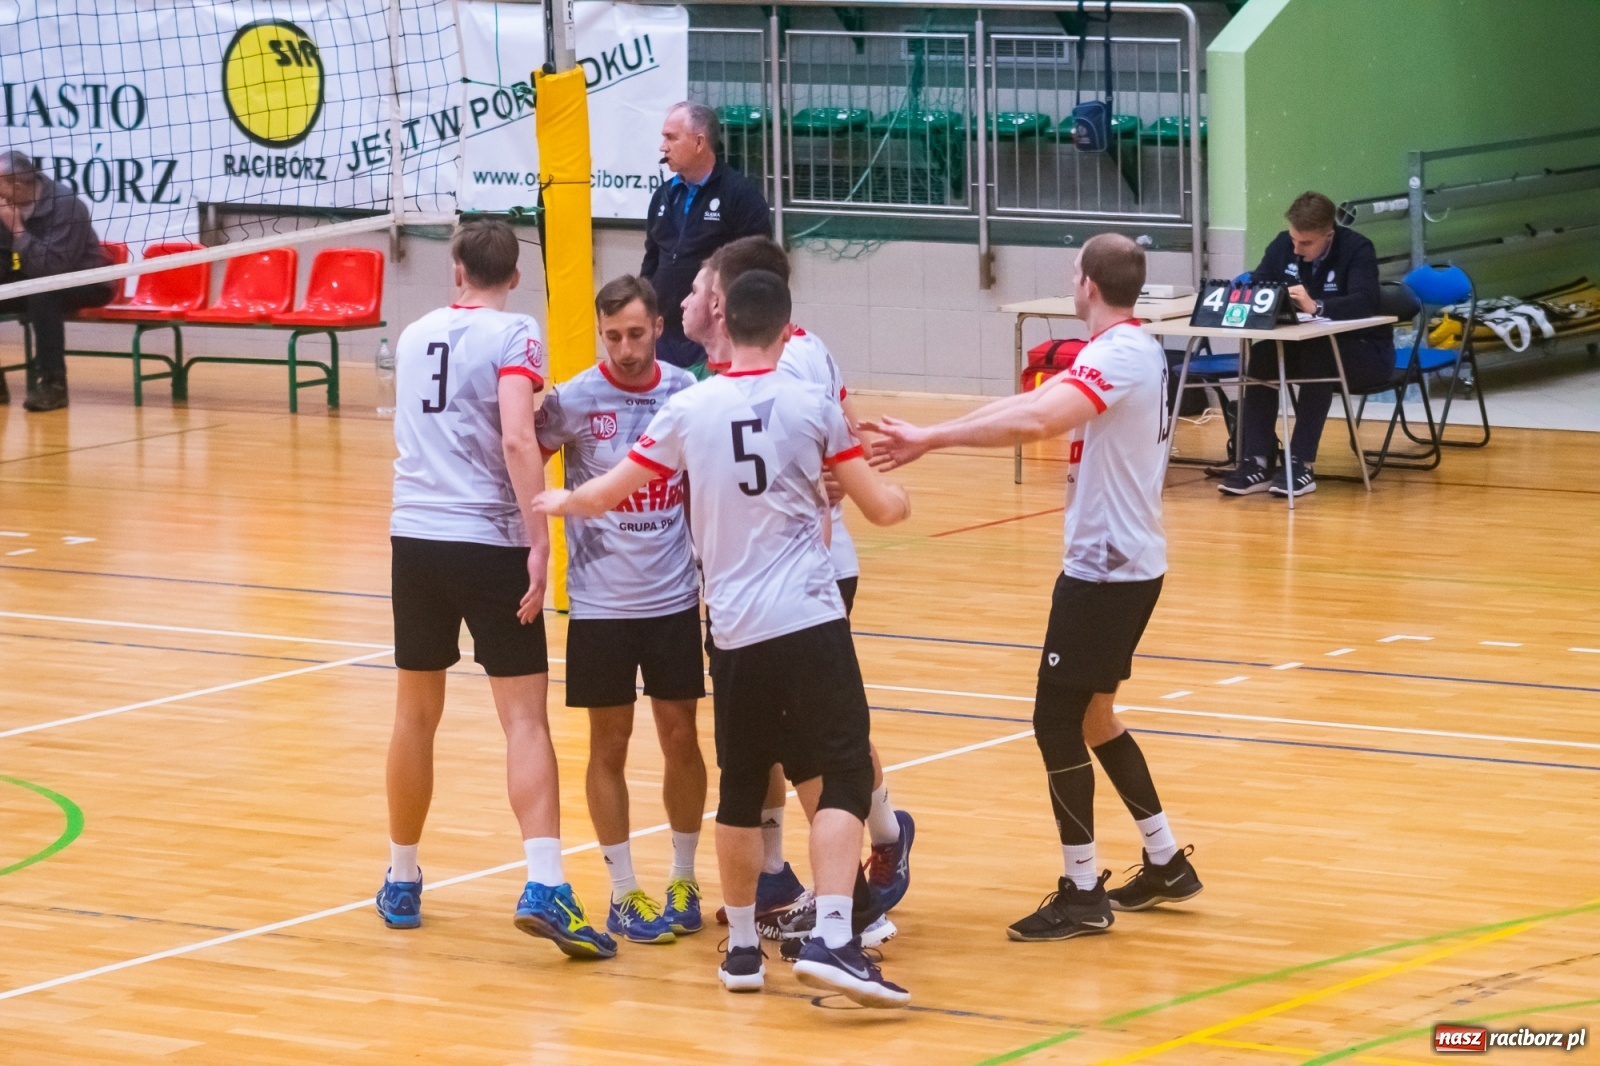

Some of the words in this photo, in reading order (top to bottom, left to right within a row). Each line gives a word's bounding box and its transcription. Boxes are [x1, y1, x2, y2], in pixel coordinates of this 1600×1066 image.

[430, 105, 462, 141] W
[469, 33, 656, 130] PORDKU!
[223, 151, 328, 180] RACIBÓRZ
[1202, 287, 1225, 312] 4
[1252, 288, 1275, 313] 9
[422, 342, 449, 413] 3
[731, 418, 768, 496] 5
[619, 521, 658, 533] GRUPA
